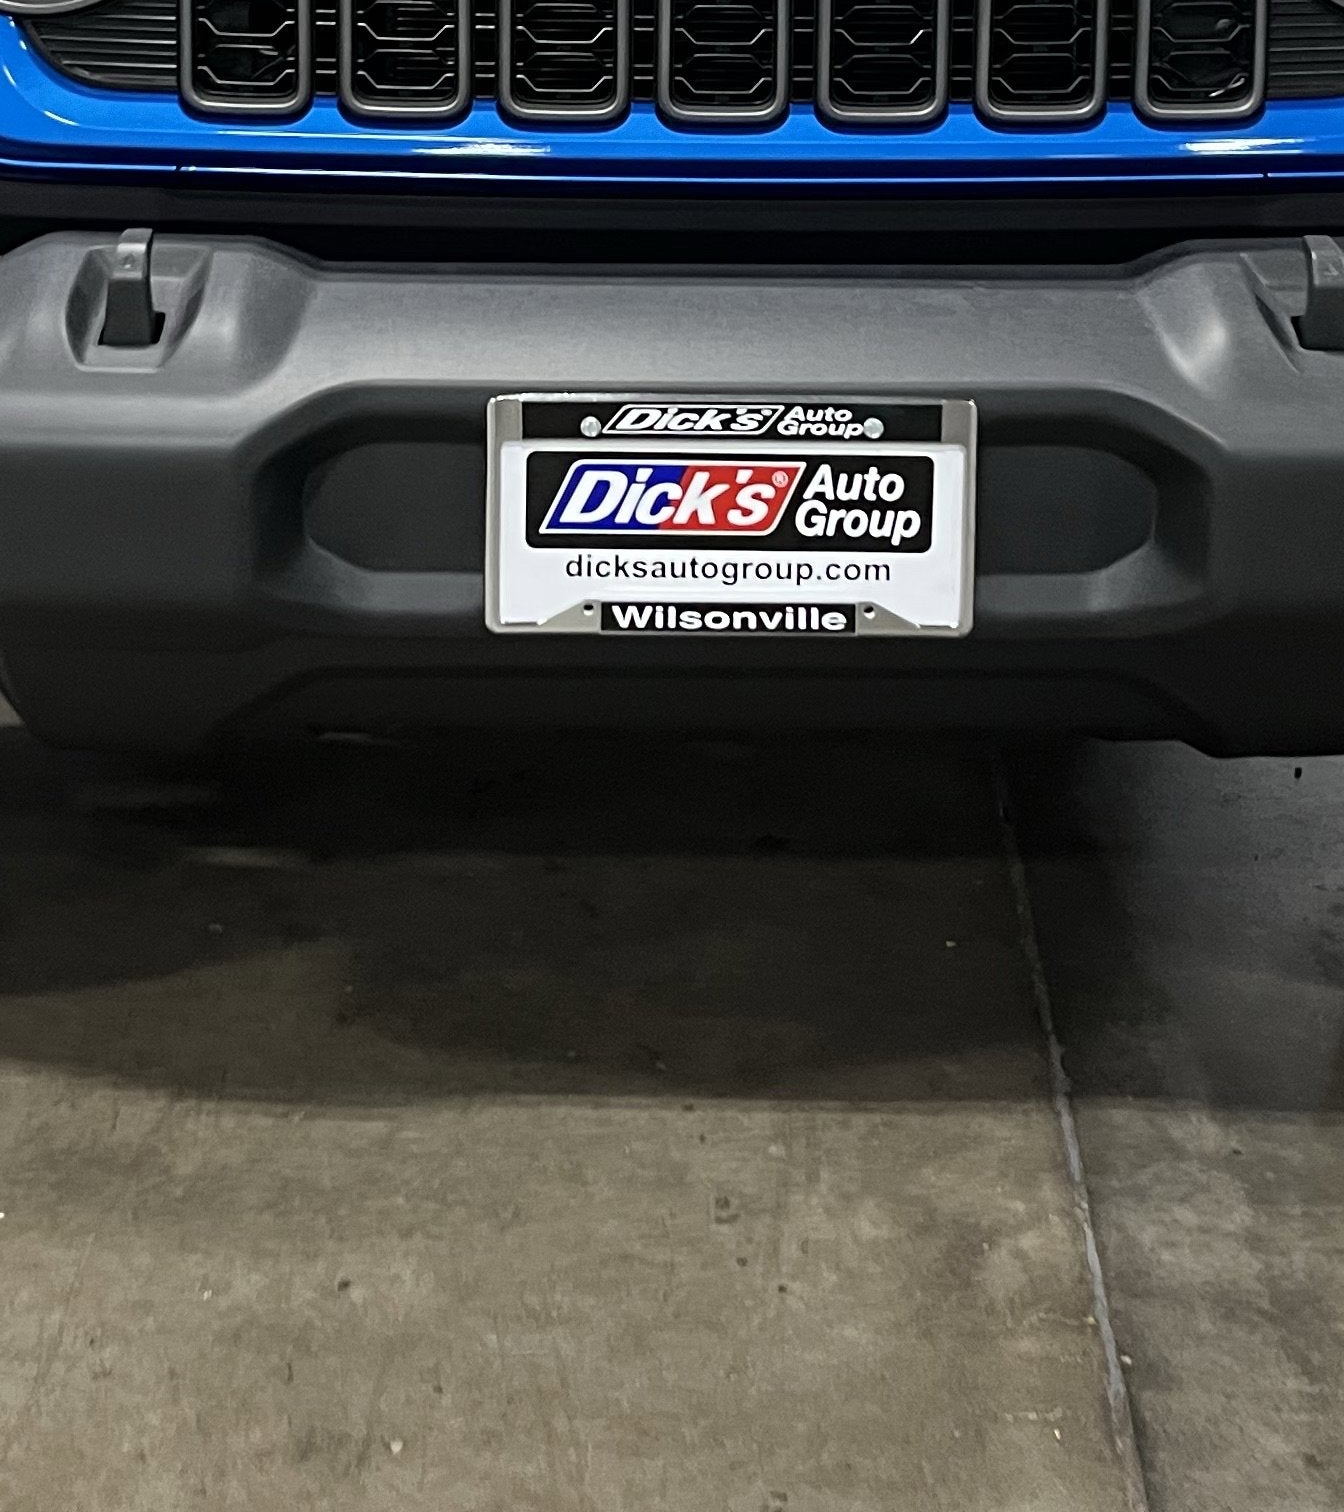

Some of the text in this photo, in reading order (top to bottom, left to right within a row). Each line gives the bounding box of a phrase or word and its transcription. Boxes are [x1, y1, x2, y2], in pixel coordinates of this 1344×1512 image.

[616, 405, 853, 431] Dick's Auto
[777, 419, 864, 439] Group
[559, 464, 905, 526] Dick's Auto
[795, 499, 922, 545] Group
[565, 554, 892, 586] dicksautogroup.com
[611, 605, 848, 631] Wilsonville
